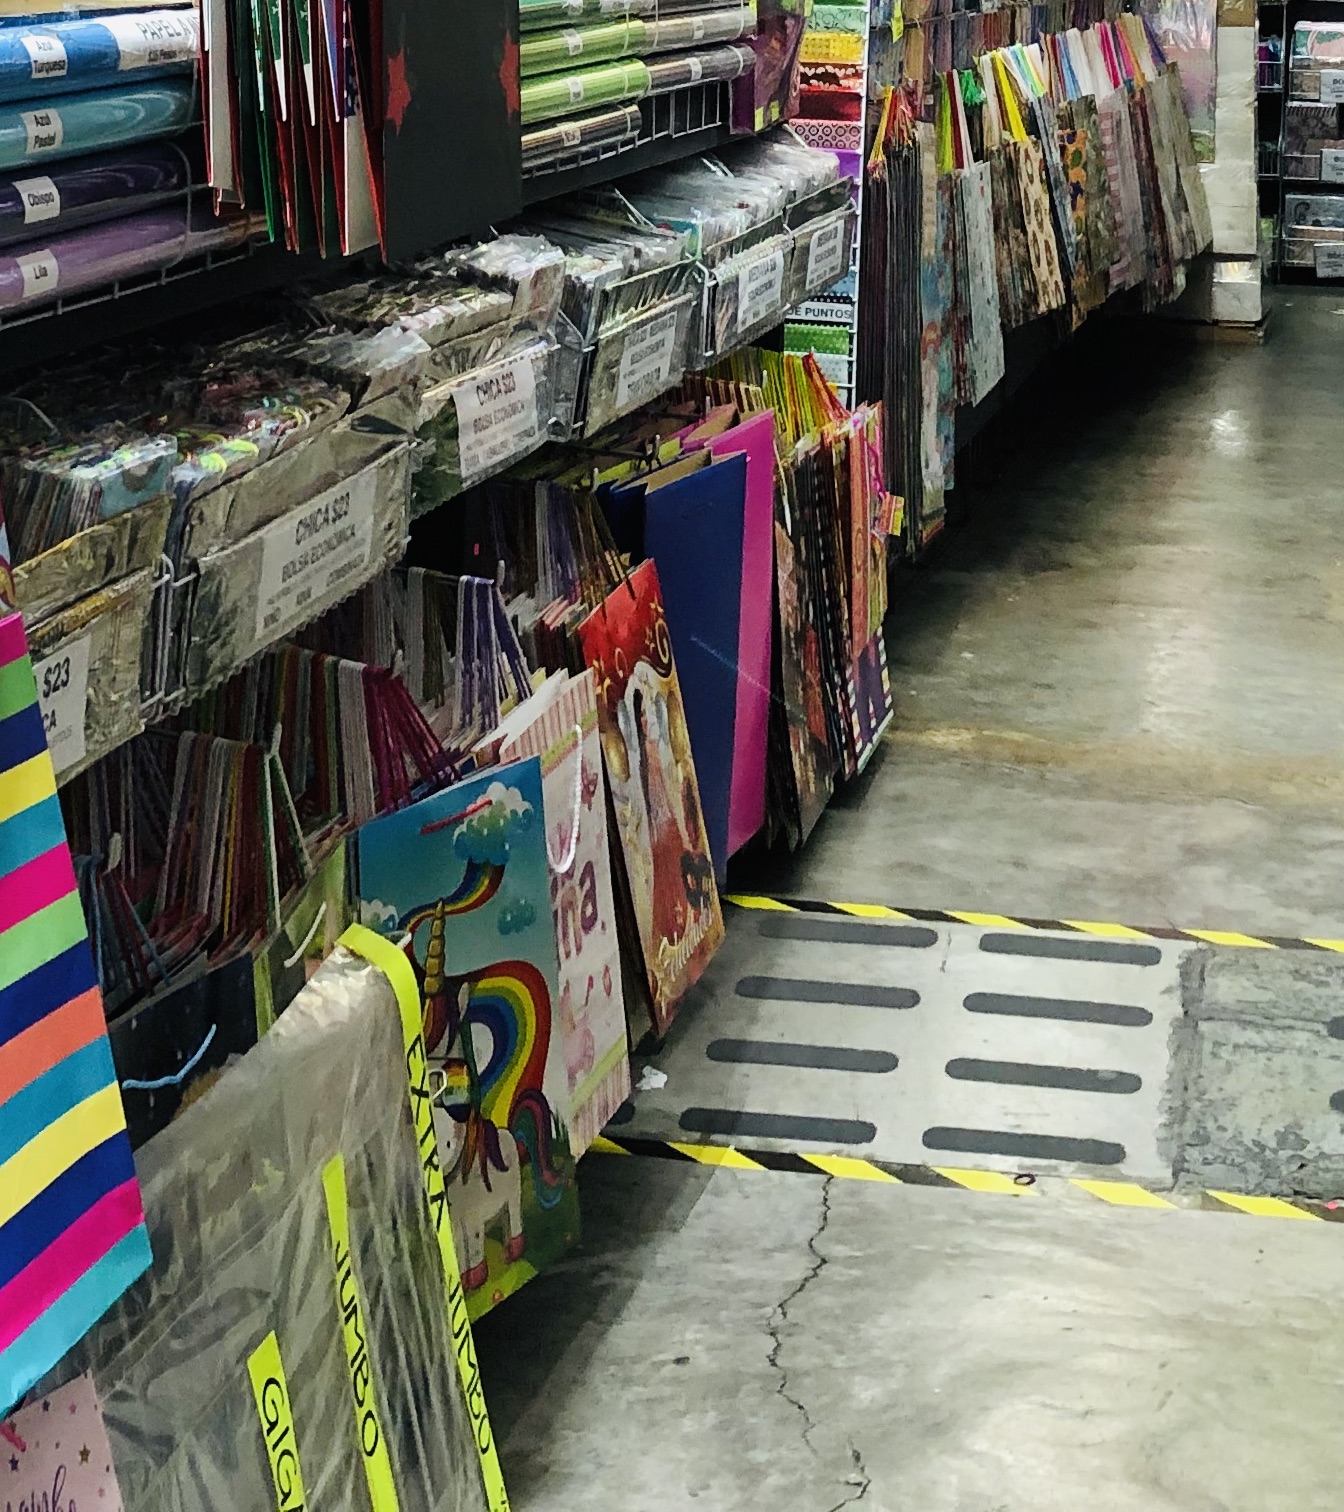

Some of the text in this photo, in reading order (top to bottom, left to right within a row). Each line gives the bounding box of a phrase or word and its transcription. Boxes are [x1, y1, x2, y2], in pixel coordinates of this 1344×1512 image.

[805, 307, 852, 319] PUNTOS
[405, 1033, 492, 1457] EXTRA JUMBO
[333, 1239, 381, 1458] JUMBO
[261, 1376, 306, 1512] GIG
